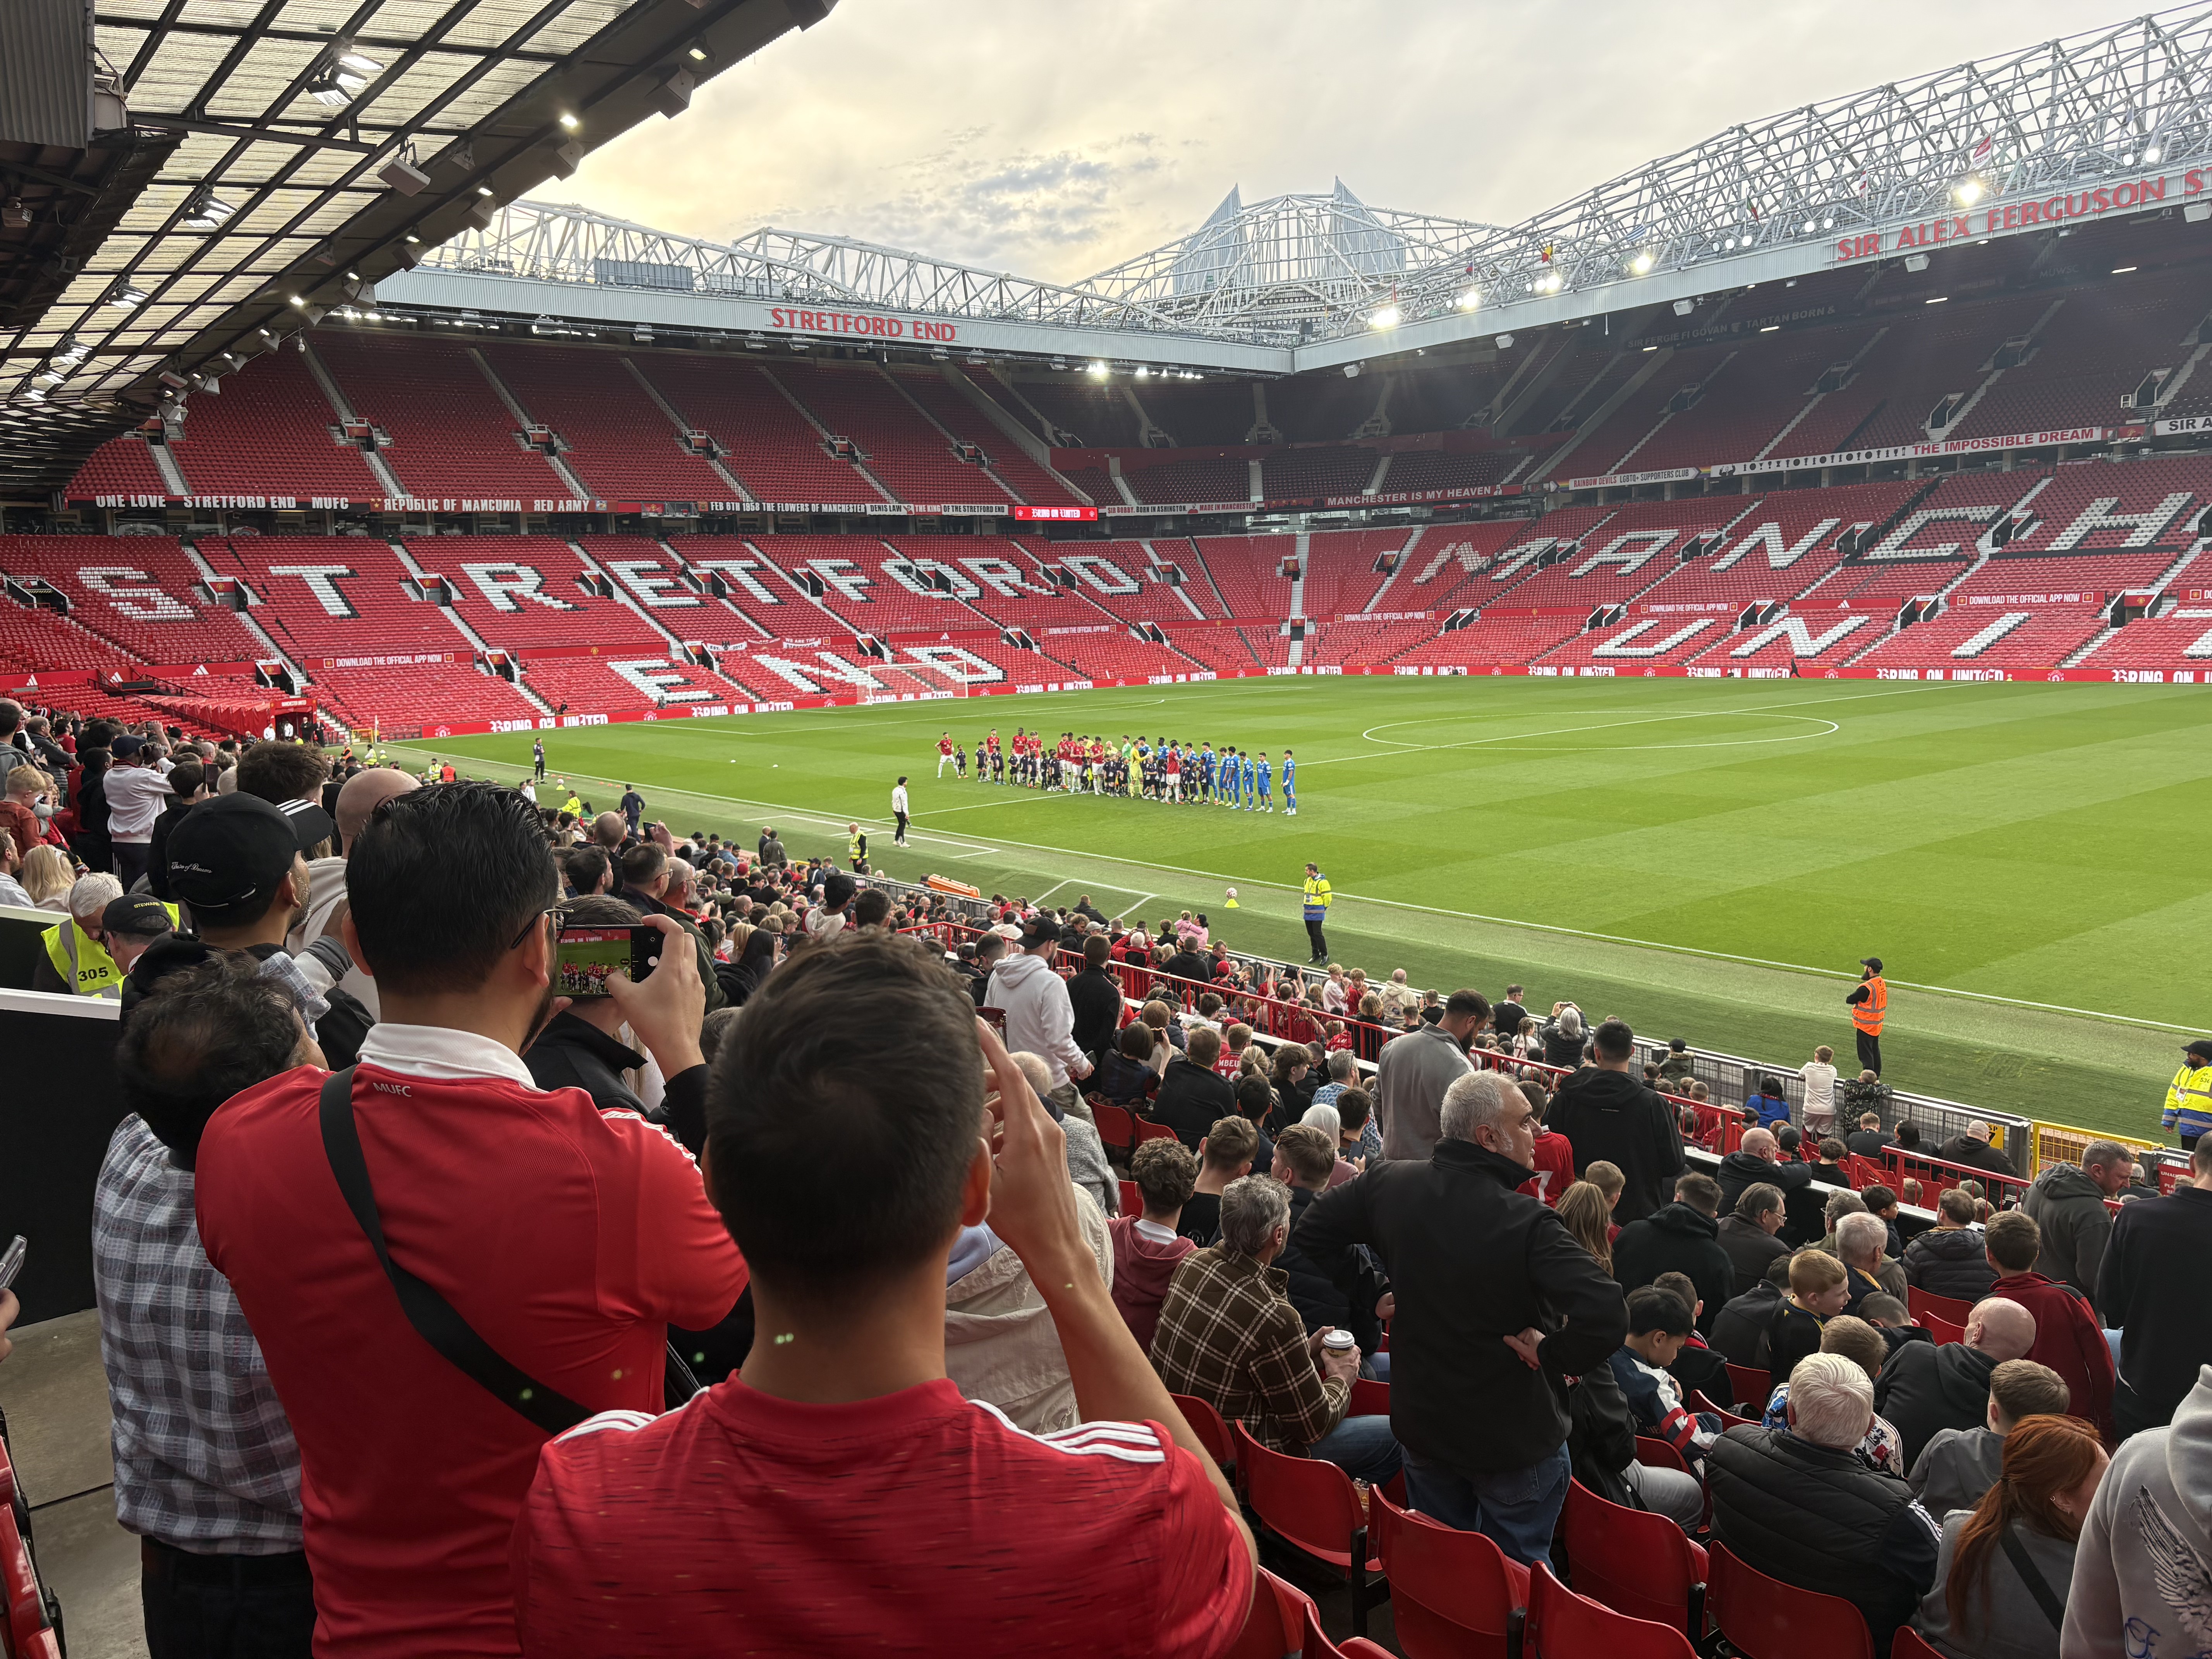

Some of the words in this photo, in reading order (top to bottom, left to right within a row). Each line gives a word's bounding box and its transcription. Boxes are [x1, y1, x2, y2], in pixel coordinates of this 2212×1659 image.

[1837, 233, 1880, 261] SIR
[1896, 214, 1971, 250] ALEX
[1987, 175, 2165, 232] FERGUSON
[771, 307, 903, 337] STRETFORD
[913, 320, 955, 341] END
[1628, 336, 1644, 348] SIR
[1645, 333, 1679, 347] FERGIE
[1692, 325, 1728, 338] GOVAN
[1747, 314, 1790, 329] TARTAN
[1792, 307, 1825, 321] BORN
[2169, 418, 2197, 432] SIR
[1912, 443, 1940, 455] THE
[1944, 433, 2034, 452] IMPOSSIBLE
[2039, 428, 2094, 444] DREAM
[1573, 477, 1597, 488] RAINBOW
[1599, 476, 1617, 485] DEVILS
[1620, 474, 1639, 483] LGBTQ+
[1640, 470, 1674, 481] SUPPORTERS
[1675, 469, 1689, 477] CLUB
[130, 495, 166, 508] LOVE
[183, 496, 266, 508] STRETFORD
[270, 496, 296, 508] END
[1327, 493, 1407, 506] MANCHESTER
[1411, 492, 1422, 500] IS
[1426, 490, 1442, 500] MY
[1447, 486, 1491, 498] HEAVEN
[311, 497, 349, 510] MUFC
[443, 498, 457, 511] OF
[710, 502, 724, 511] FEB
[726, 502, 740, 511] 6TH
[742, 502, 760, 512] 1958
[762, 502, 776, 512] THE
[777, 503, 809, 512] FLOWERS
[811, 503, 819, 512] OF
[822, 503, 865, 513] MANCHESTER
[76, 556, 1142, 621] STRETFORD
[1969, 595, 2005, 605] DOWNLOAD
[2006, 595, 2018, 603] THE
[2020, 594, 2048, 604] OFFICIAL
[2049, 594, 2063, 603] APP
[2064, 593, 2080, 602] NOW
[1649, 604, 1675, 613] DOWNLOAD
[1686, 603, 1705, 612] OFFICIAL
[1717, 603, 1728, 611] NOW
[1344, 613, 1372, 622] DOWNLOAD
[1373, 613, 1382, 621] THE
[1383, 612, 1403, 620] OFFICIAL
[336, 658, 373, 668] DOWNLOAD
[373, 657, 386, 666] THE
[387, 656, 414, 666] OFFICIAL
[415, 656, 426, 664] APP
[427, 655, 442, 663] NOW
[1927, 669, 1944, 680] ON
[2173, 671, 2194, 683] ON
[78, 967, 109, 982] 305
[1218, 1059, 1240, 1068] MBEU
[373, 1082, 412, 1097] MUFC
